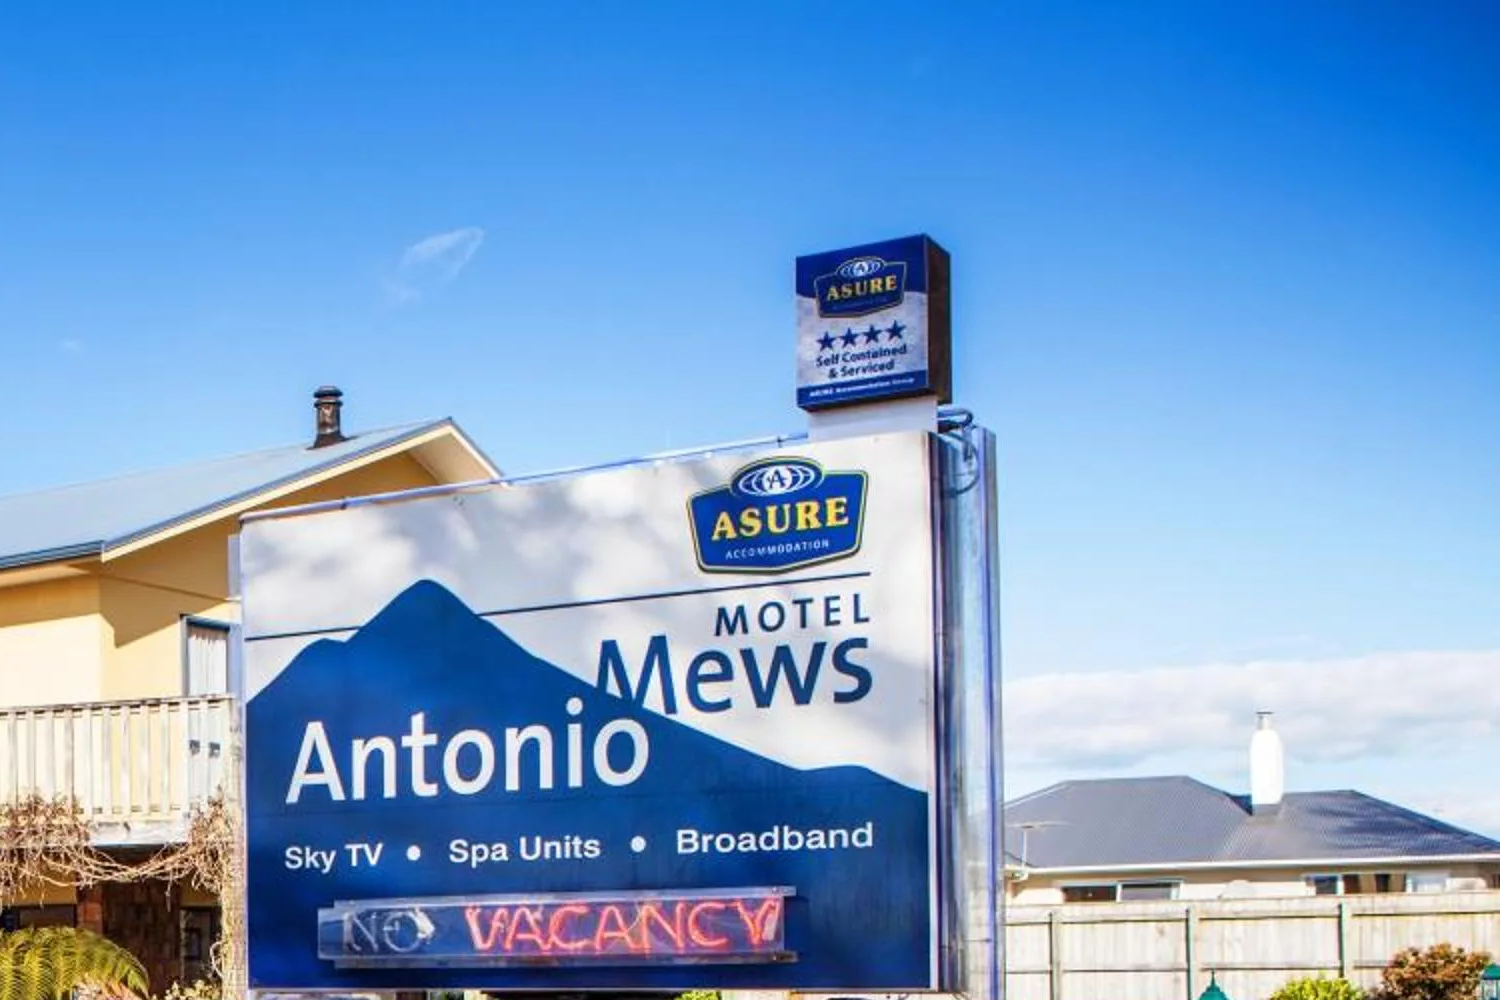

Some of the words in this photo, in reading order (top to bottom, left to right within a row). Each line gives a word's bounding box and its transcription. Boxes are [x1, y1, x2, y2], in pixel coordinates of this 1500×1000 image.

[827, 275, 897, 301] ASURE
[816, 352, 840, 368] Self
[841, 343, 907, 363] Contained
[828, 367, 838, 379] &
[840, 360, 894, 378] Serviced
[711, 497, 849, 541] ASURE
[726, 539, 830, 561] ACCOMMODATION
[714, 593, 870, 637] MOTEL
[596, 634, 873, 715] Mews
[286, 697, 650, 804] Antonio
[285, 845, 336, 874] Sky
[345, 842, 384, 868] TV
[449, 839, 509, 868] Spa
[519, 835, 601, 861] Units
[676, 822, 874, 854] Broadband
[343, 909, 423, 952] NO
[464, 897, 781, 953] VACANCY
